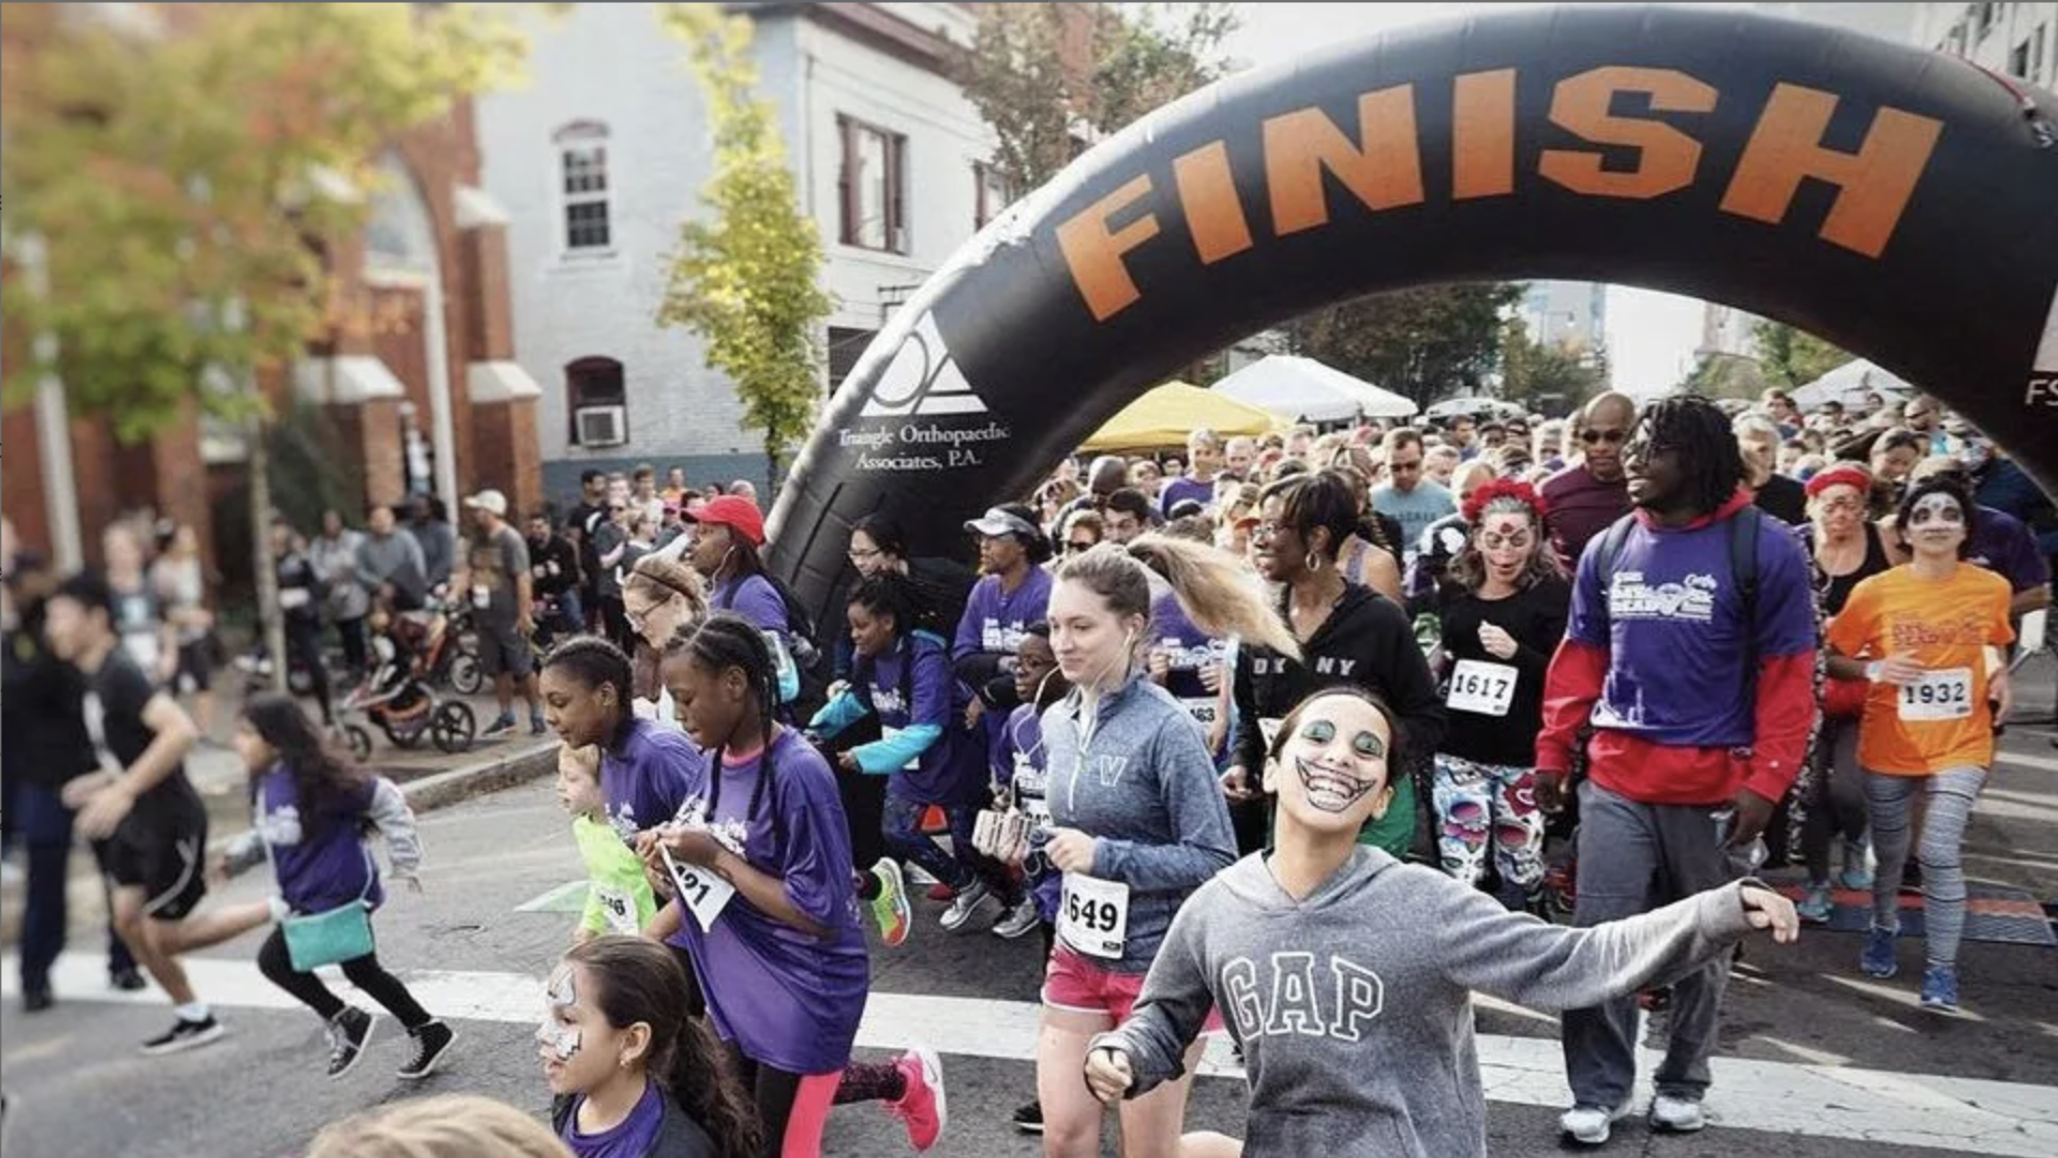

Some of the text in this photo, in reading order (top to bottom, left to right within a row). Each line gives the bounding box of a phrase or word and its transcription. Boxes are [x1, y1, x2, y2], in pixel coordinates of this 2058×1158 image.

[1055, 66, 1944, 322] FINISH
[839, 422, 1010, 450] Triangle Orthopaedic
[856, 450, 943, 470] Associates,
[1454, 673, 1508, 699] 1617
[1905, 682, 1964, 704] 1932
[1064, 888, 1118, 932] 1649
[1222, 952, 1383, 1041] GAP
